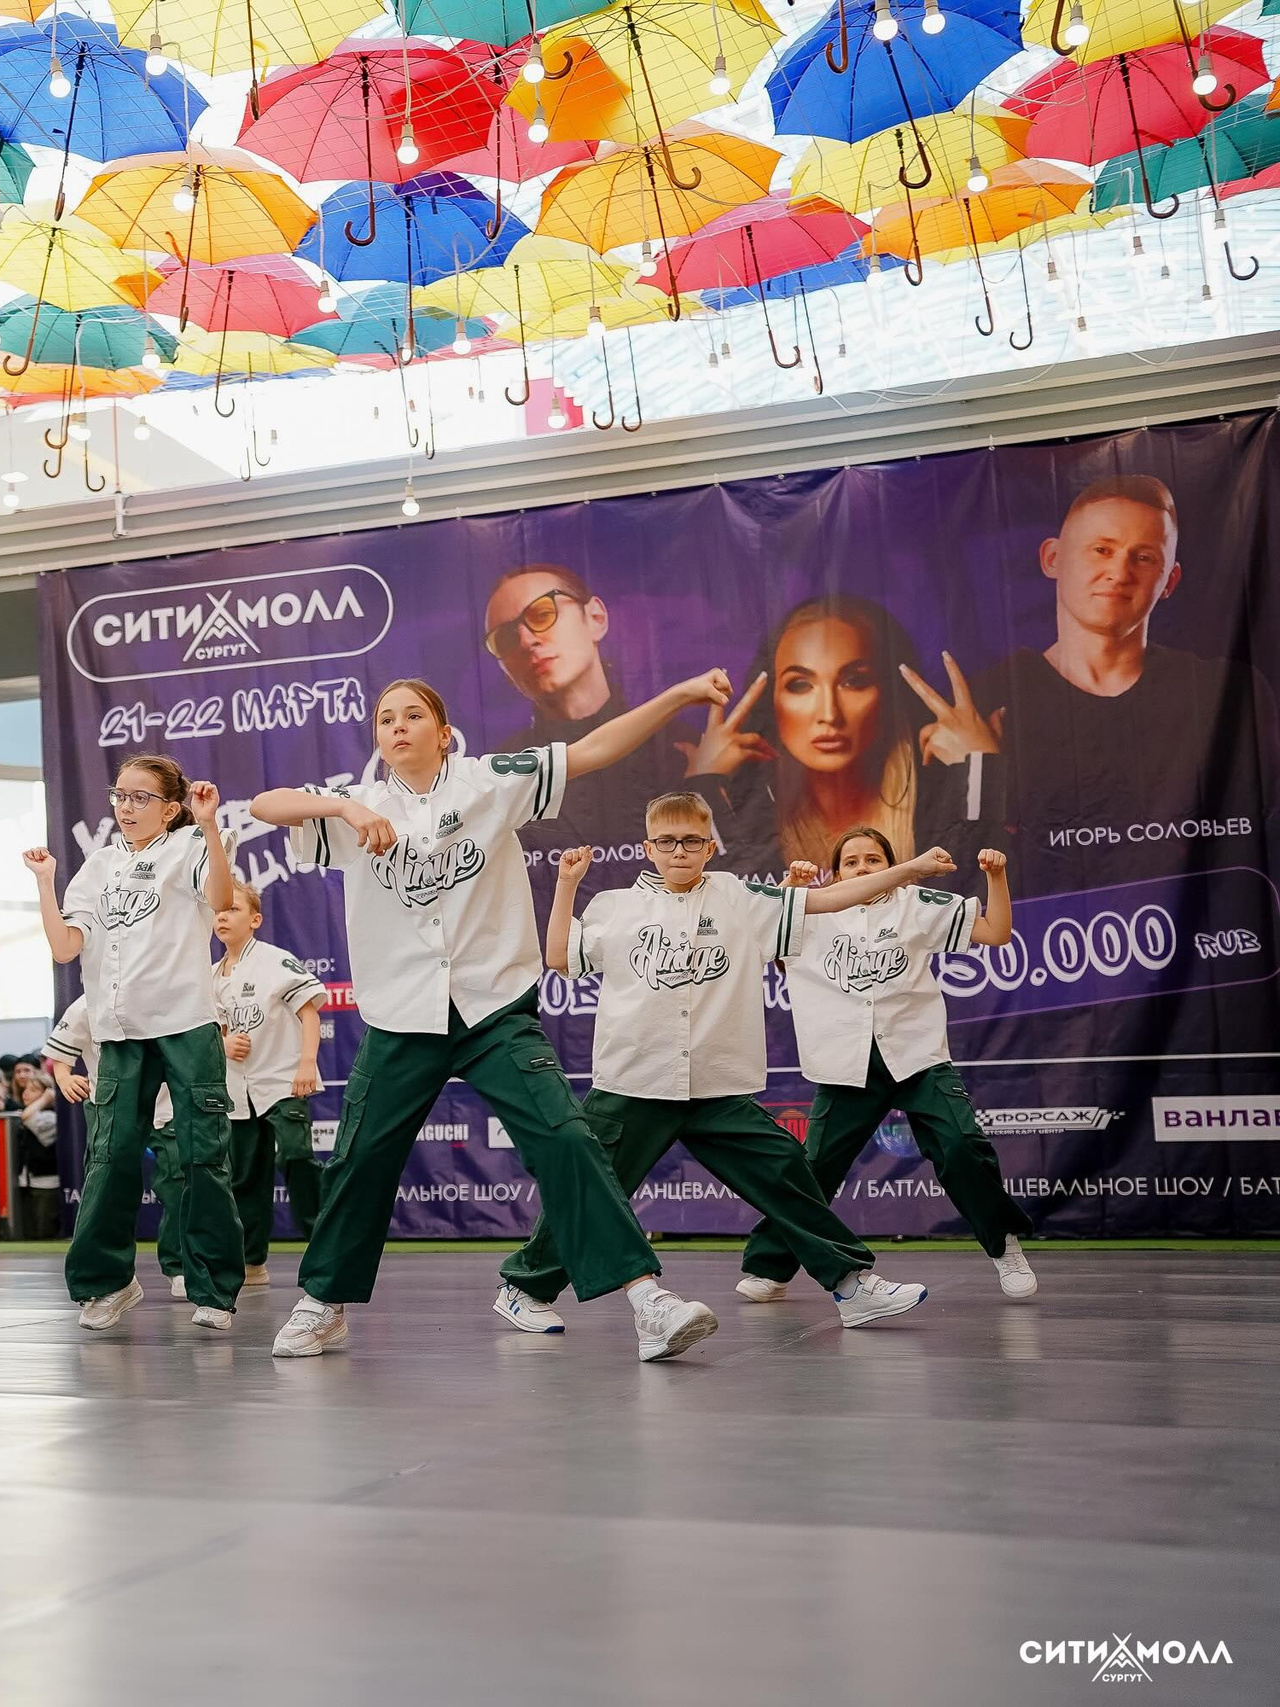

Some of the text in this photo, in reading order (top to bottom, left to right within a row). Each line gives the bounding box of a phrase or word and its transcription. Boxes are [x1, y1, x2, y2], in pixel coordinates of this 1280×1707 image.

[93, 585, 365, 647] СИТИ МОЛЛ
[195, 643, 248, 660] СУРГУТ
[98, 677, 366, 747] 21-22 МАРТА
[1049, 817, 1252, 847] ИГОРЬ СОЛОВЬЕВ
[1194, 928, 1262, 960] RUB
[995, 1110, 1091, 1123] ФОРСАЖ
[415, 1123, 469, 1141] AGUCHI
[395, 1183, 470, 1202] АЛЬНОЕ
[474, 1182, 522, 1201] ШОУ
[632, 1181, 741, 1202] АНЦЕВАЛ
[1002, 1177, 1149, 1199] ЦЕВАЛЬНОЕ
[1154, 1177, 1215, 1196] ШОУ
[1240, 1177, 1280, 1196] БАТ
